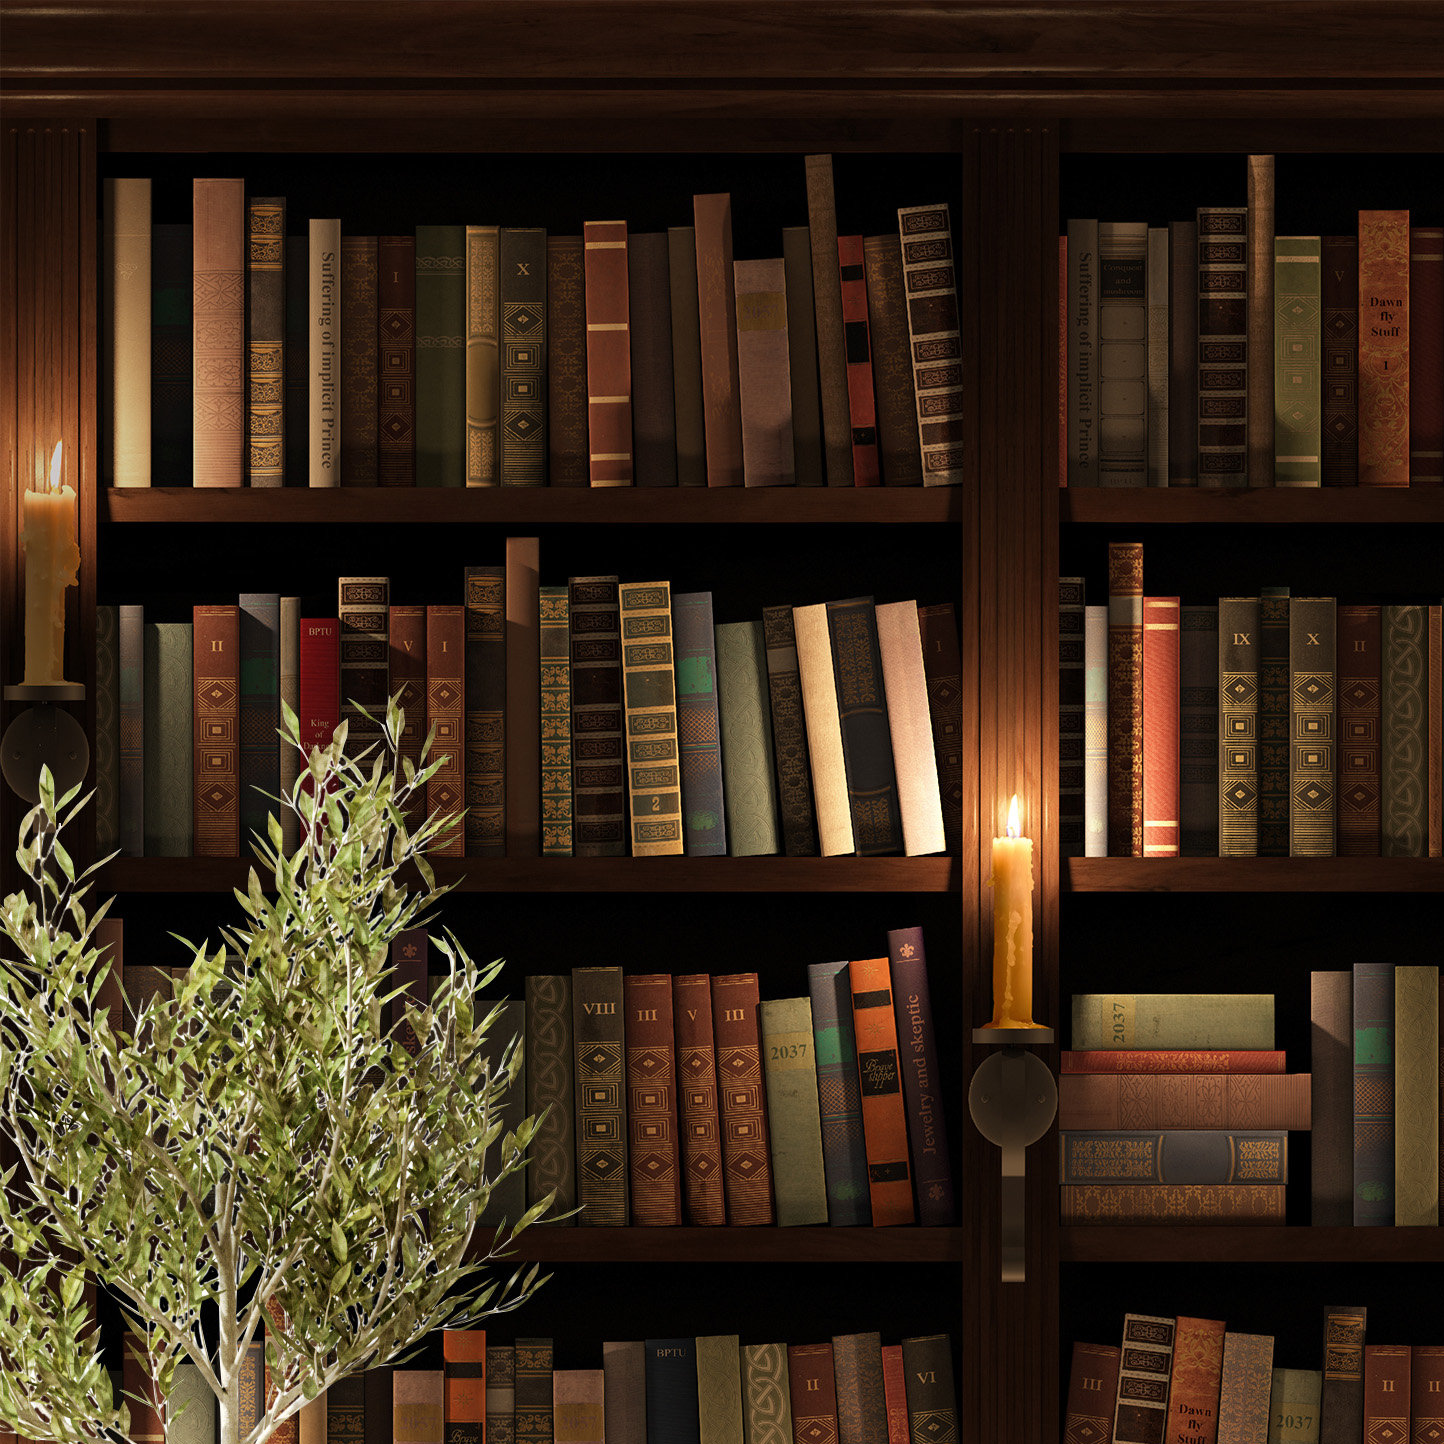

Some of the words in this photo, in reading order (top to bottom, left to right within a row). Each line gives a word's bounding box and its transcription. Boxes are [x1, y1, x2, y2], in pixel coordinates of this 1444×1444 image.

[516, 263, 530, 276] X
[1103, 262, 1143, 273] Conquest
[392, 271, 400, 283] I
[1115, 277, 1131, 285] and
[1334, 270, 1345, 281] V
[319, 251, 335, 326] Suffering
[1076, 251, 1092, 326] Suffering
[1103, 287, 1144, 295] mushroom
[1369, 297, 1404, 308] Dawn
[1379, 311, 1394, 323] fly
[1370, 326, 1402, 337] Stuff
[321, 331, 335, 347] of
[1079, 331, 1092, 347] of
[318, 352, 335, 412] implicit
[1075, 352, 1092, 412] implicit
[321, 419, 335, 470] Prince
[1078, 419, 1092, 470] Prince
[308, 626, 332, 637] BPTU
[211, 640, 224, 652] II
[403, 640, 414, 652] V
[1232, 633, 1251, 646] IX
[1306, 633, 1320, 646] X
[442, 641, 448, 652] I
[1352, 641, 1366, 653] II
[310, 719, 329, 729] King
[314, 731, 324, 739] of
[651, 796, 660, 811] 2
[583, 1002, 617, 1015] VIII
[636, 1009, 658, 1021] III
[687, 1009, 698, 1021] V
[724, 1008, 746, 1021] III
[908, 993, 926, 1050] skeptic
[1112, 1003, 1126, 1044] 2037
[770, 1044, 808, 1061] 2037
[864, 1058, 893, 1075] Brave
[868, 1070, 896, 1089] slipper
[915, 1062, 928, 1089] and
[918, 1092, 936, 1153] Jewelry
[656, 1348, 687, 1358] BPTU
[917, 1371, 937, 1384] VI
[1082, 1377, 1102, 1391] III
[806, 1379, 820, 1392] II
[1382, 1380, 1394, 1393] II
[1428, 1380, 1440, 1393] II
[1179, 1404, 1212, 1417] Dawn
[1188, 1419, 1203, 1433] fly
[1276, 1414, 1312, 1429] 2037
[448, 1429, 478, 1444] Brave
